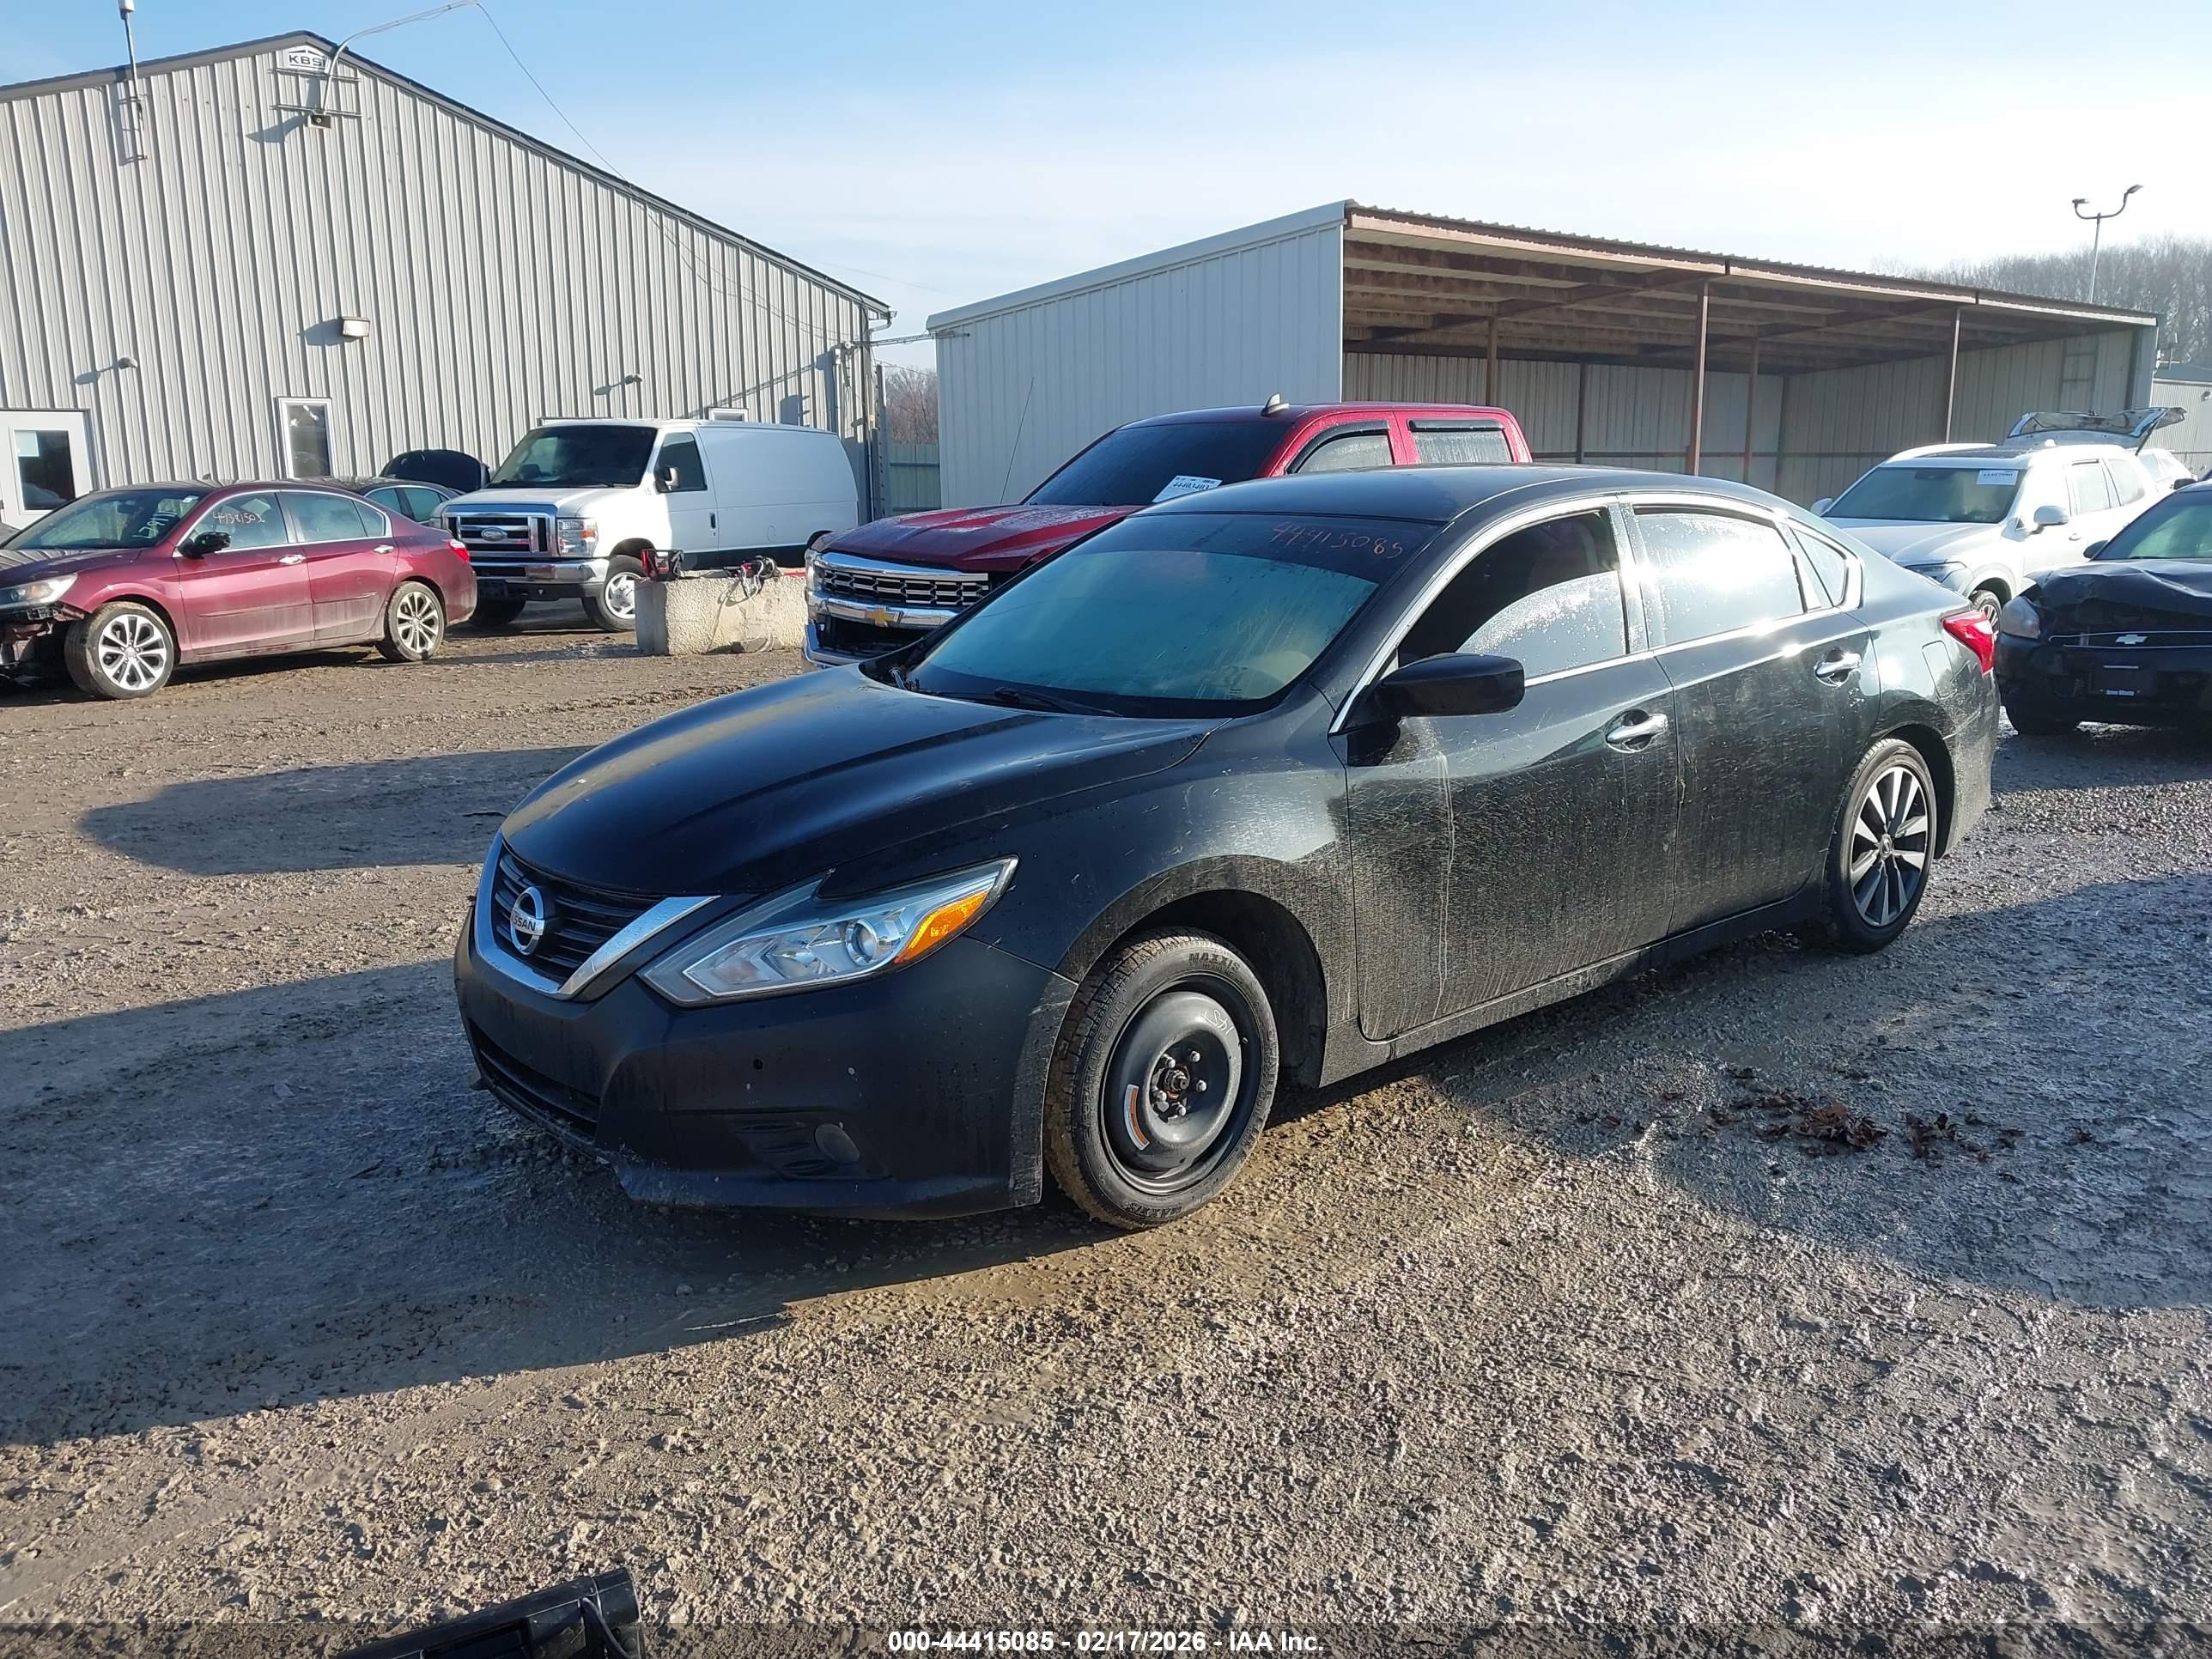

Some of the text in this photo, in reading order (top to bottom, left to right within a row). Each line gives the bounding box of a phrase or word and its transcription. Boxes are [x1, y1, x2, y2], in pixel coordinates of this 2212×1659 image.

[1268, 521, 1403, 559] 44415085
[513, 915, 537, 932] SSAN
[1188, 952, 1241, 971] MAXXIS
